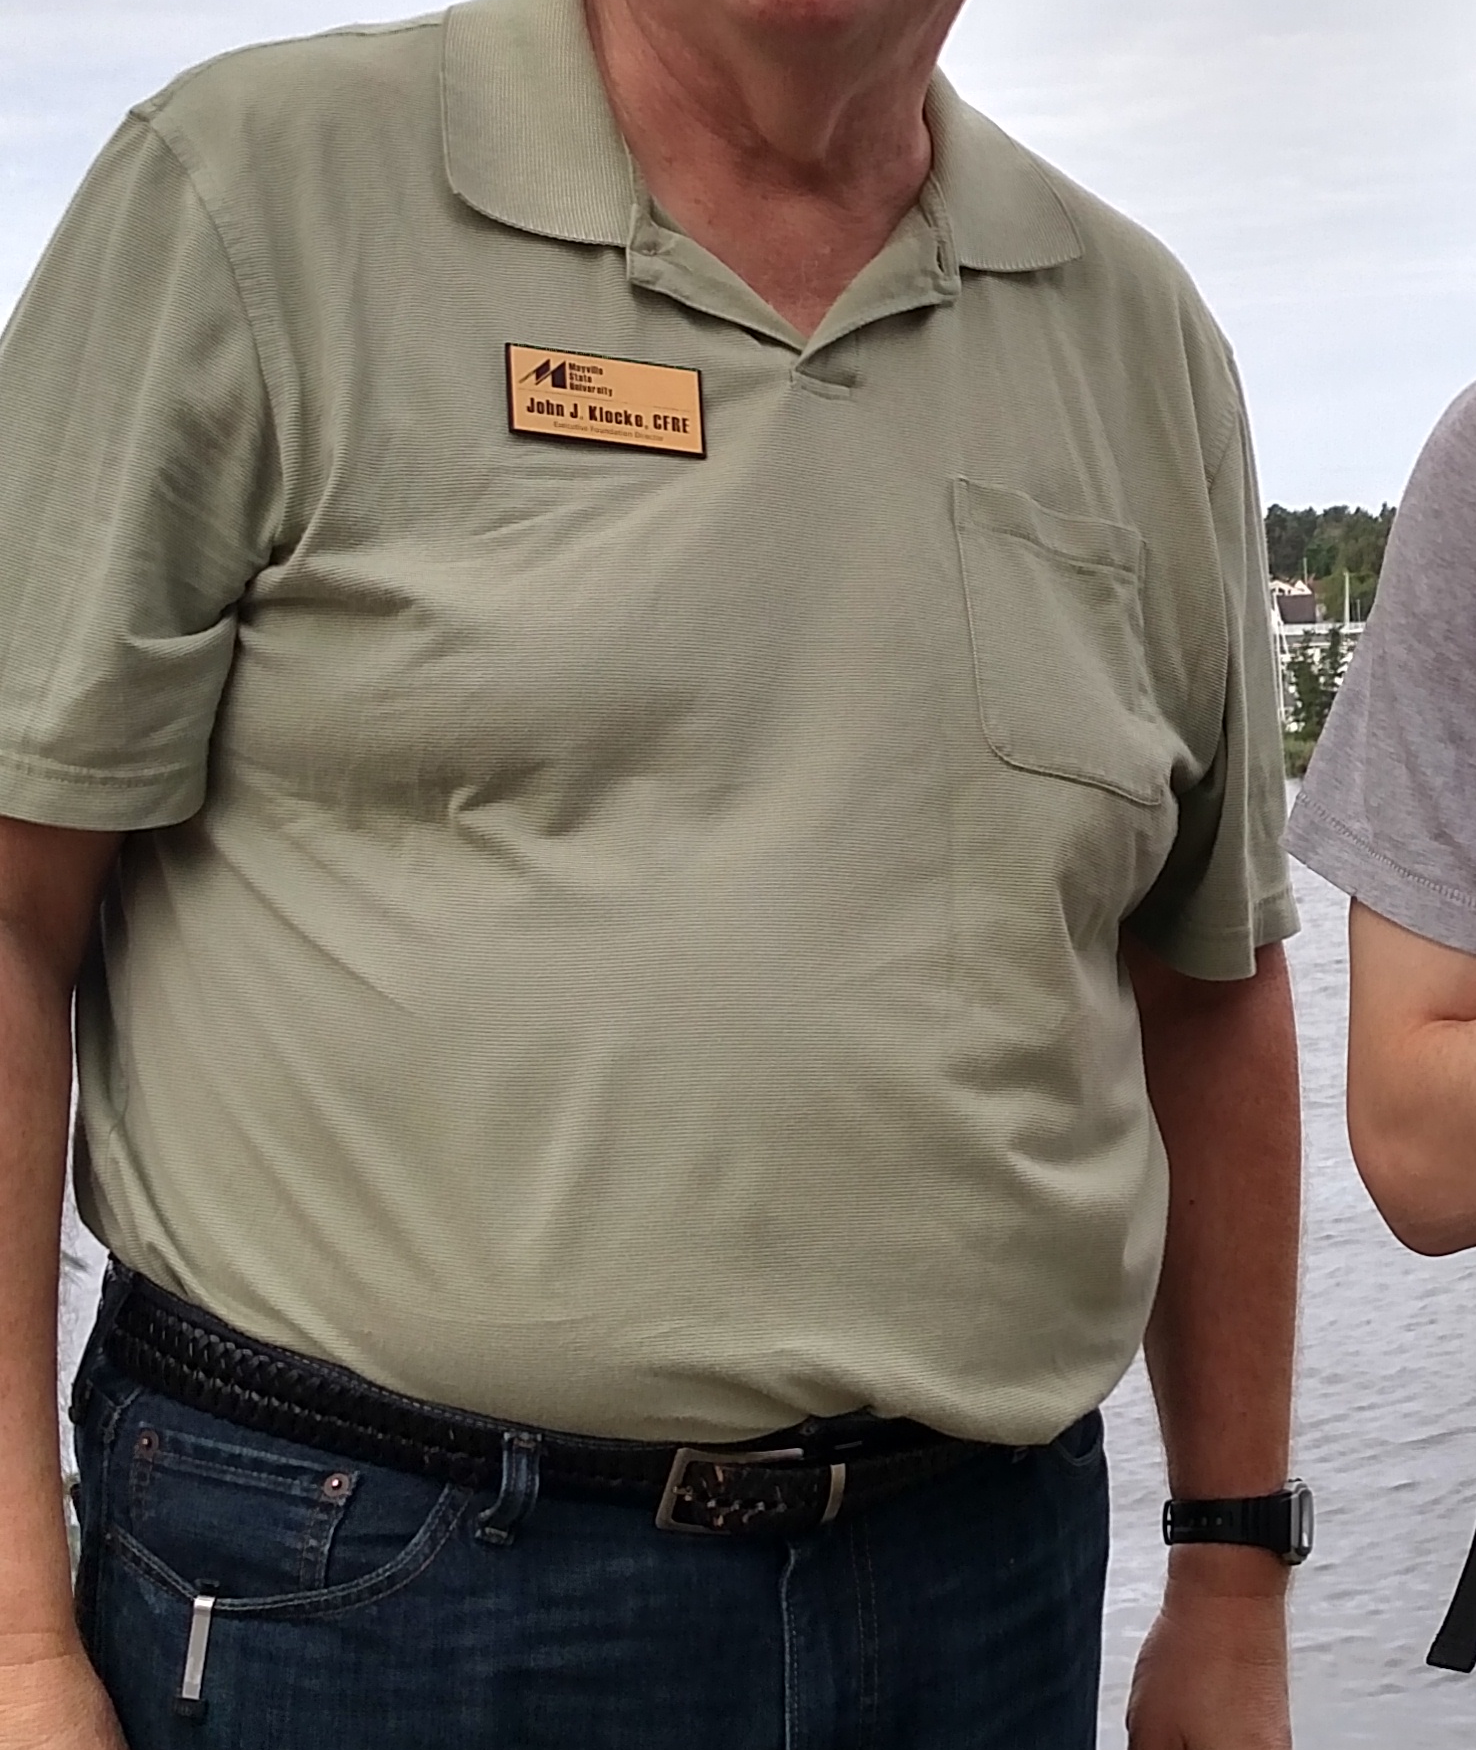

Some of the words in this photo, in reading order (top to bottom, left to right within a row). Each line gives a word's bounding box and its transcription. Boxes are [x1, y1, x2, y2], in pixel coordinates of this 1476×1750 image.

[568, 361, 604, 376] Mayville
[568, 372, 593, 383] State
[569, 381, 613, 398] University
[526, 397, 565, 418] John
[569, 402, 584, 420] J.
[653, 414, 691, 435] CFRE
